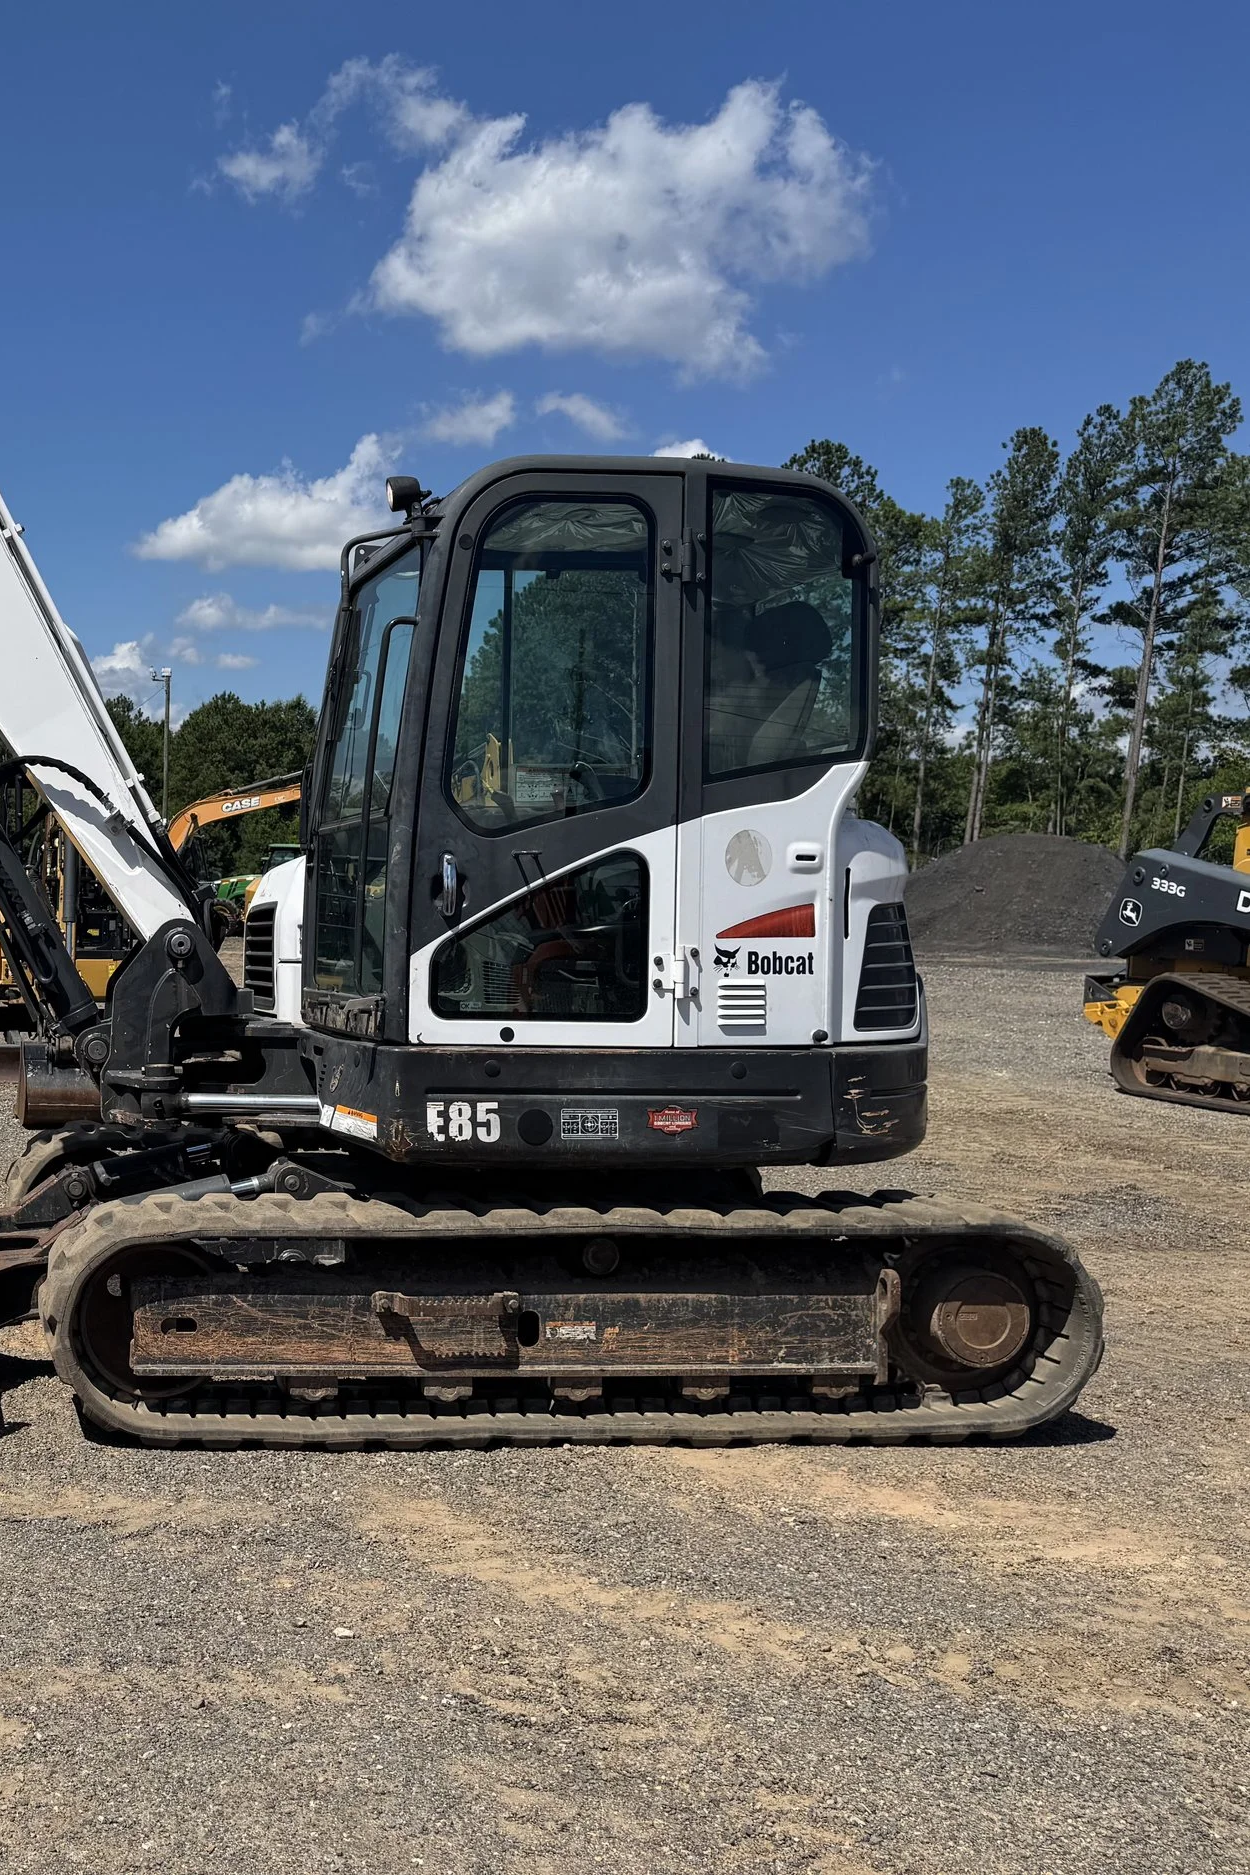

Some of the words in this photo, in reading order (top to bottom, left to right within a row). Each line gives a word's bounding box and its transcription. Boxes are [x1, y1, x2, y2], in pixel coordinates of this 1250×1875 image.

[222, 796, 260, 812] CASE
[1151, 877, 1187, 897] 333G
[748, 951, 814, 975] Bobcat
[426, 1101, 501, 1143] E85
